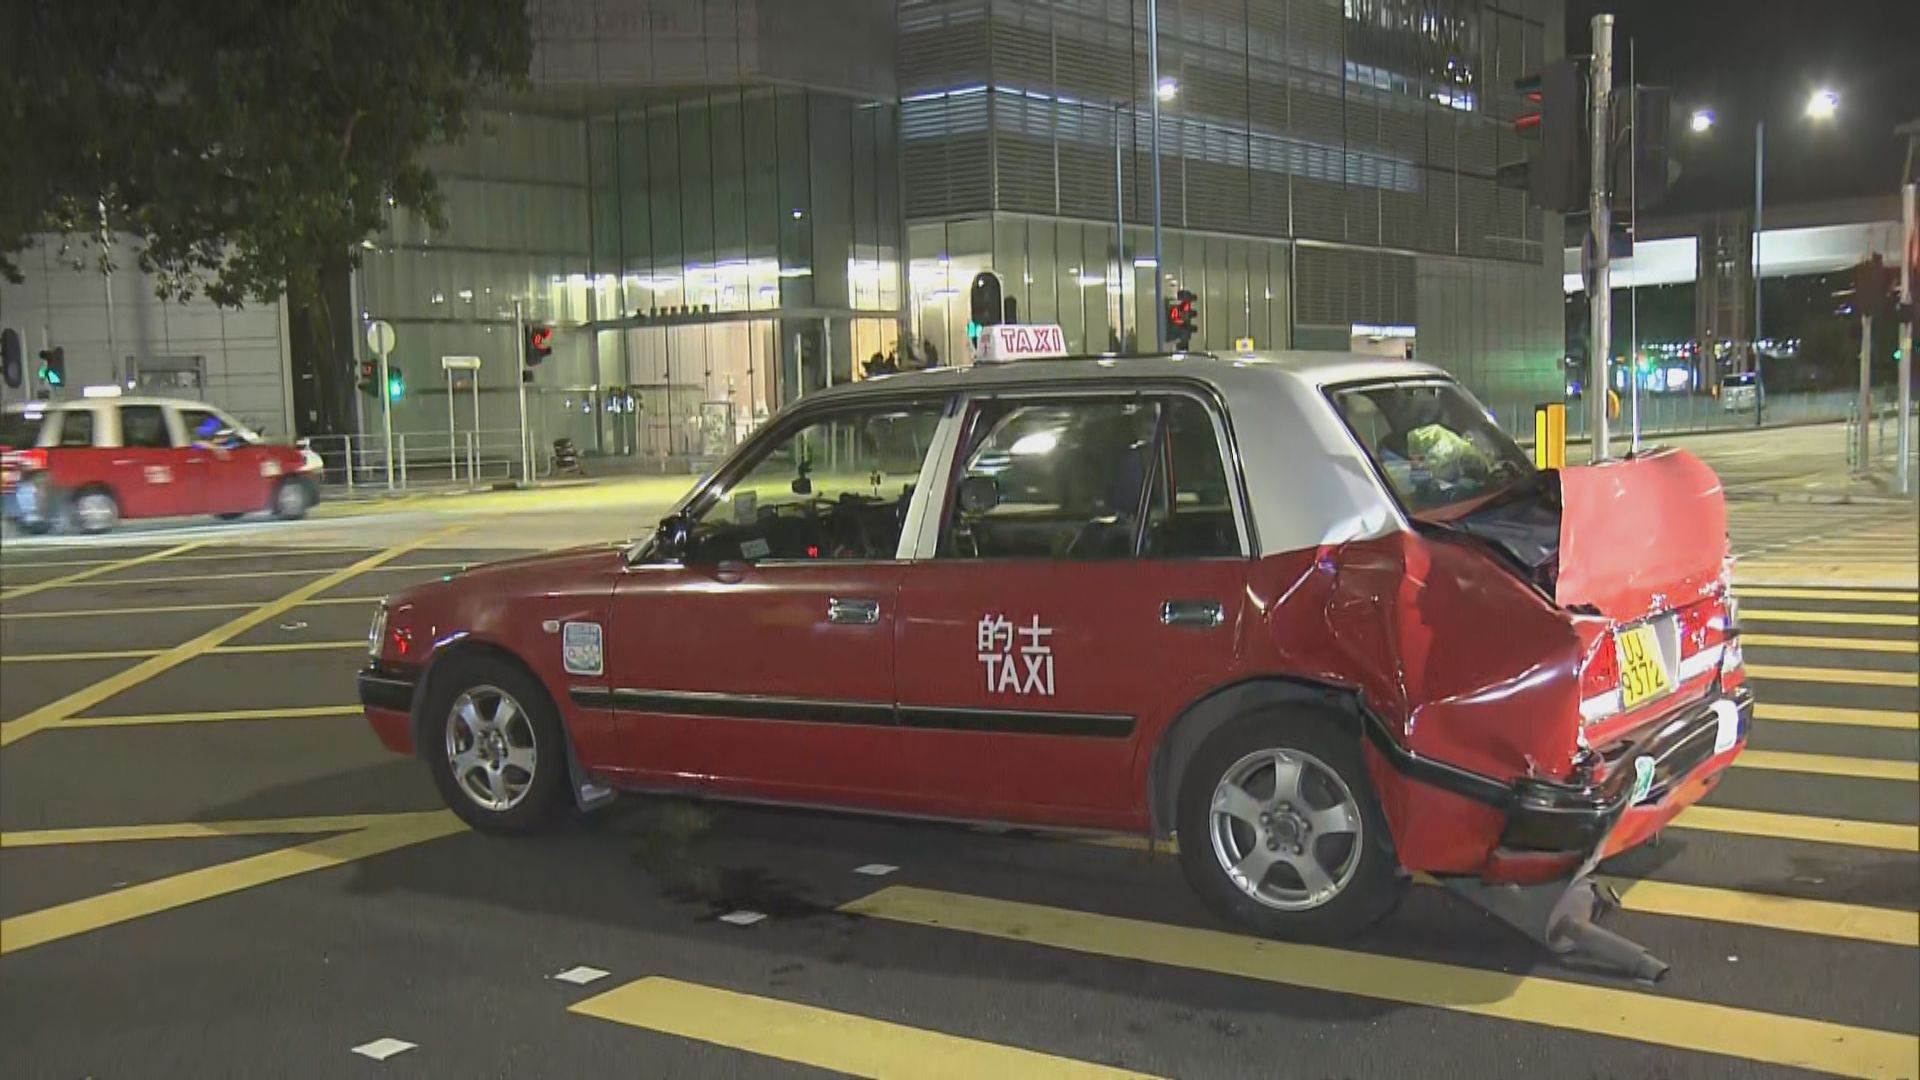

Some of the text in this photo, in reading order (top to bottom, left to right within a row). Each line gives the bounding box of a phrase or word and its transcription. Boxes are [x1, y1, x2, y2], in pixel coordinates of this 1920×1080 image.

[1001, 328, 1061, 353] TAXI
[978, 613, 1053, 653] 的士
[1620, 631, 1644, 666] UJ
[978, 653, 1055, 696] TAXI
[1622, 659, 1664, 701] 9372
